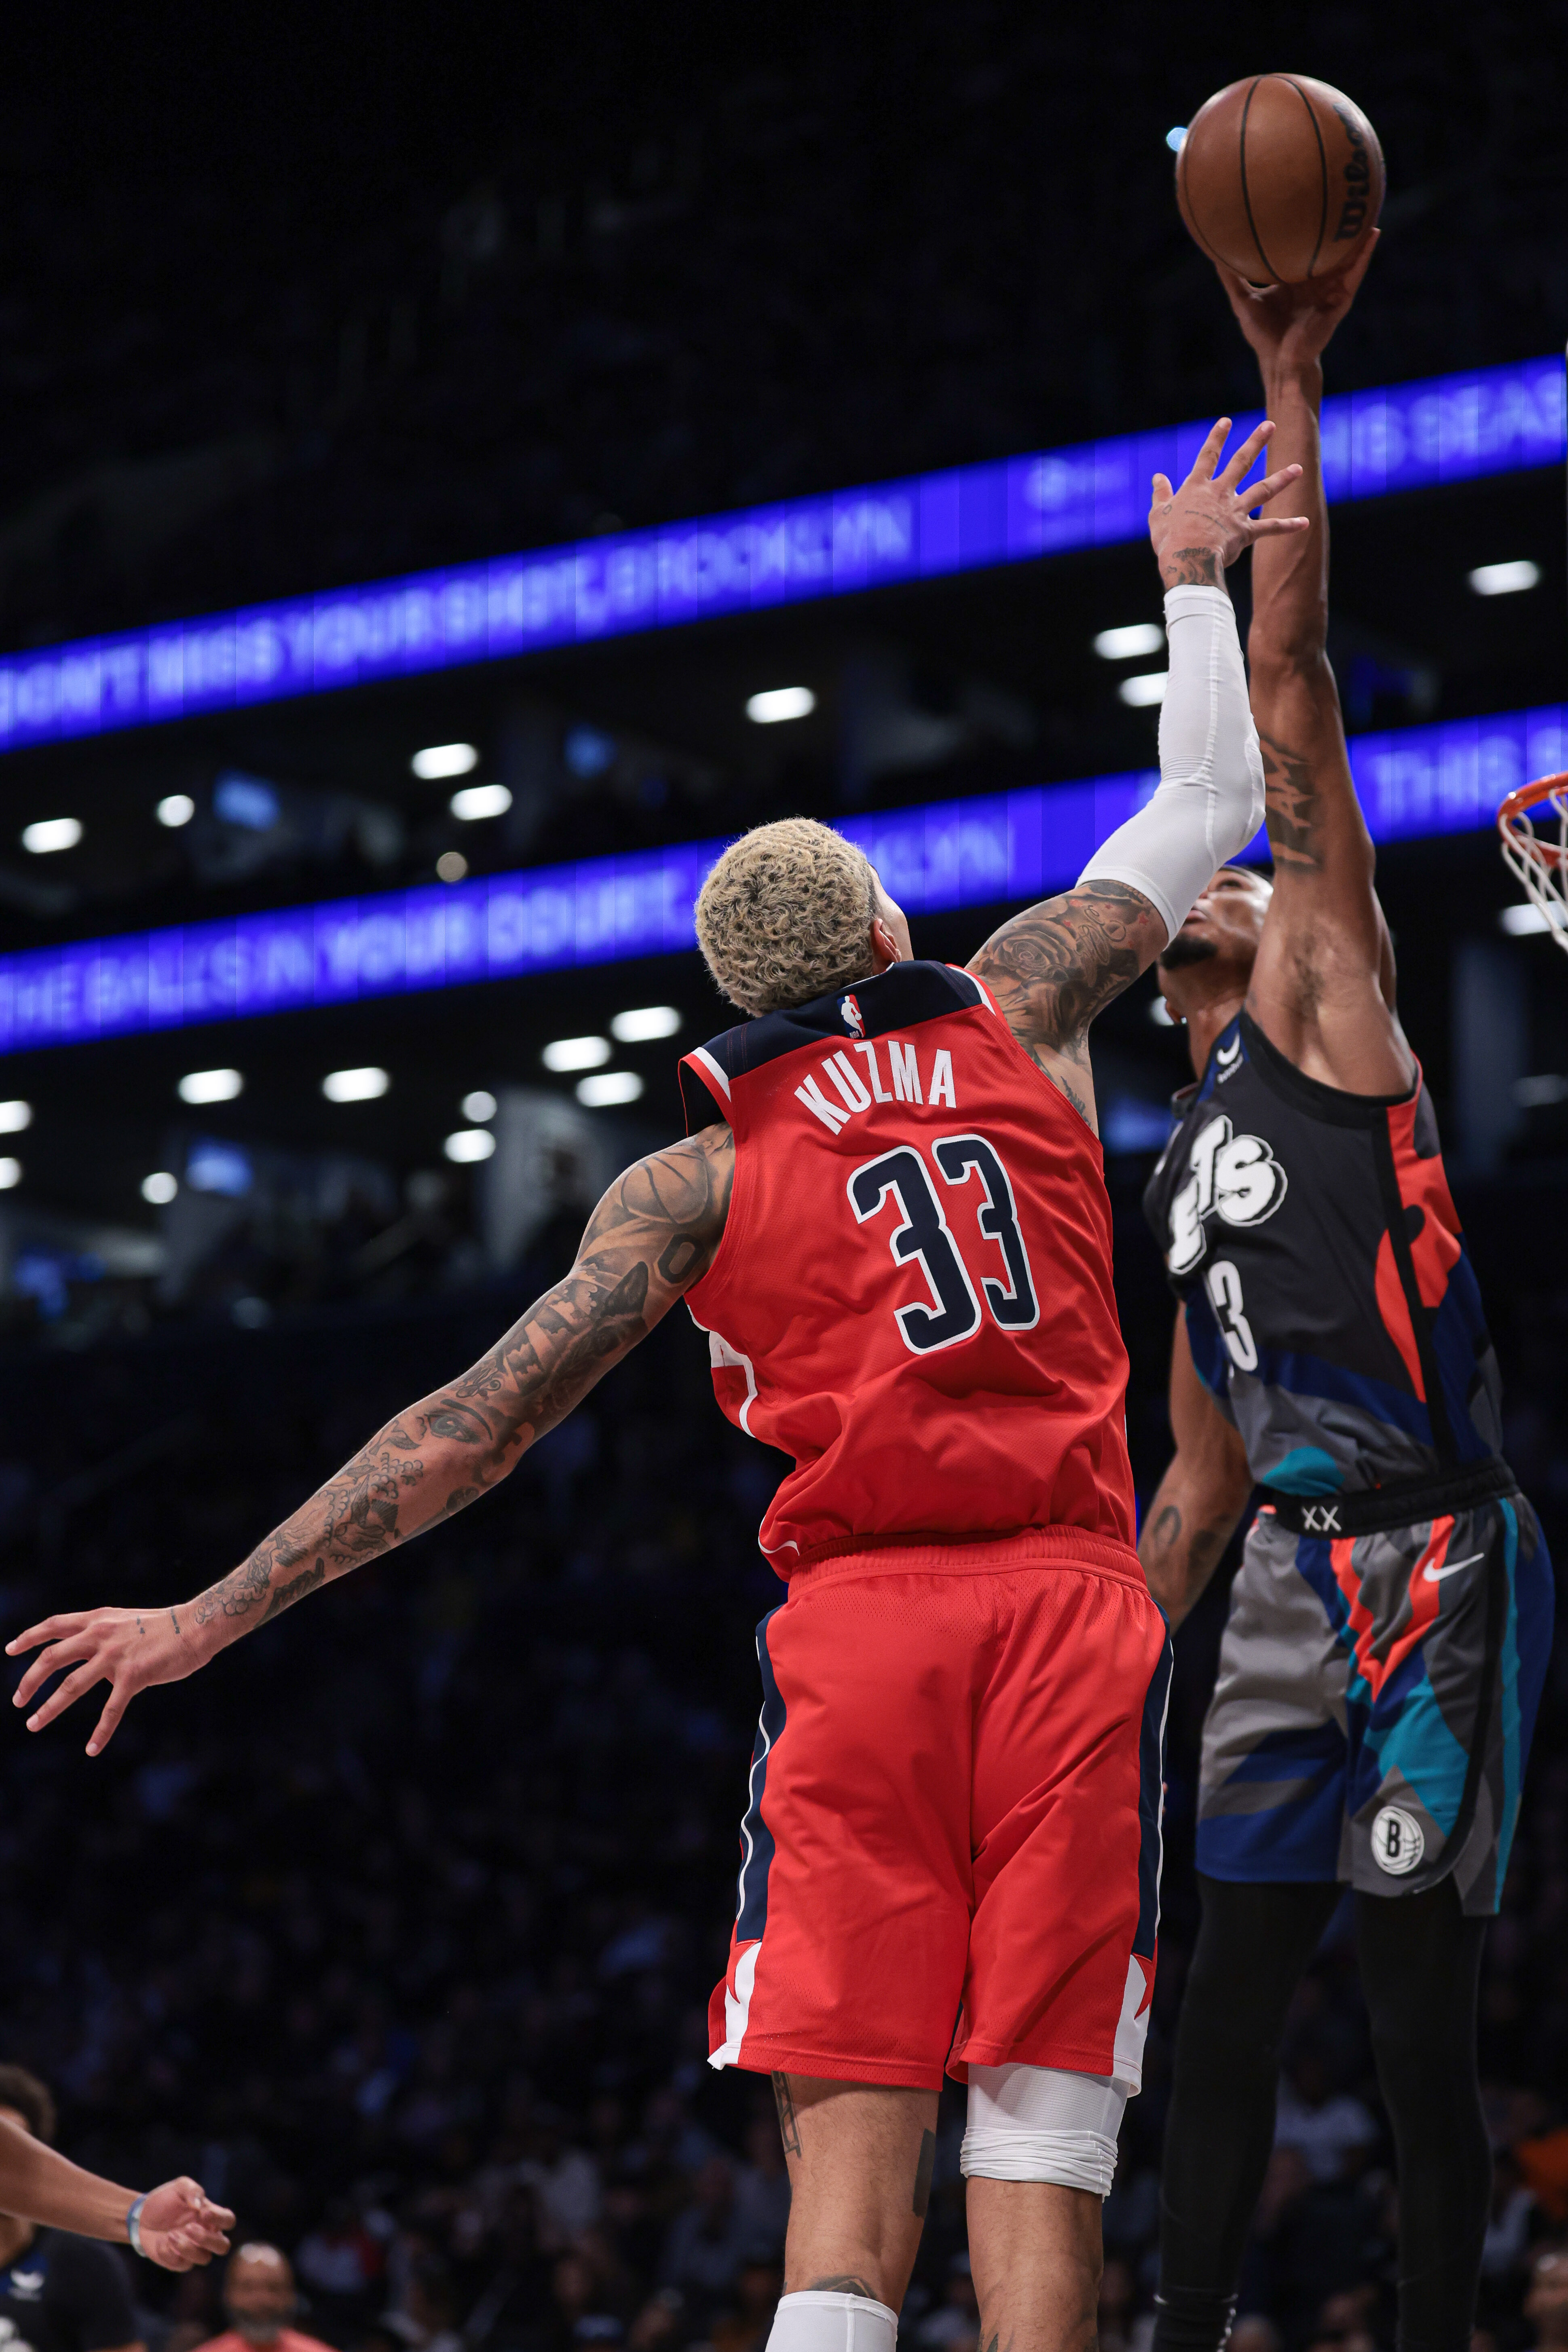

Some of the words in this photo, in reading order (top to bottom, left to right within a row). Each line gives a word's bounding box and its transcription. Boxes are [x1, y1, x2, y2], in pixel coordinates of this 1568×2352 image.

[850, 1031, 860, 1039] NBA
[794, 1040, 957, 1135] KUZMA
[847, 1134, 1040, 1355] 33
[1302, 1506, 1342, 1532] XX
[1387, 1819, 1401, 1858] B
